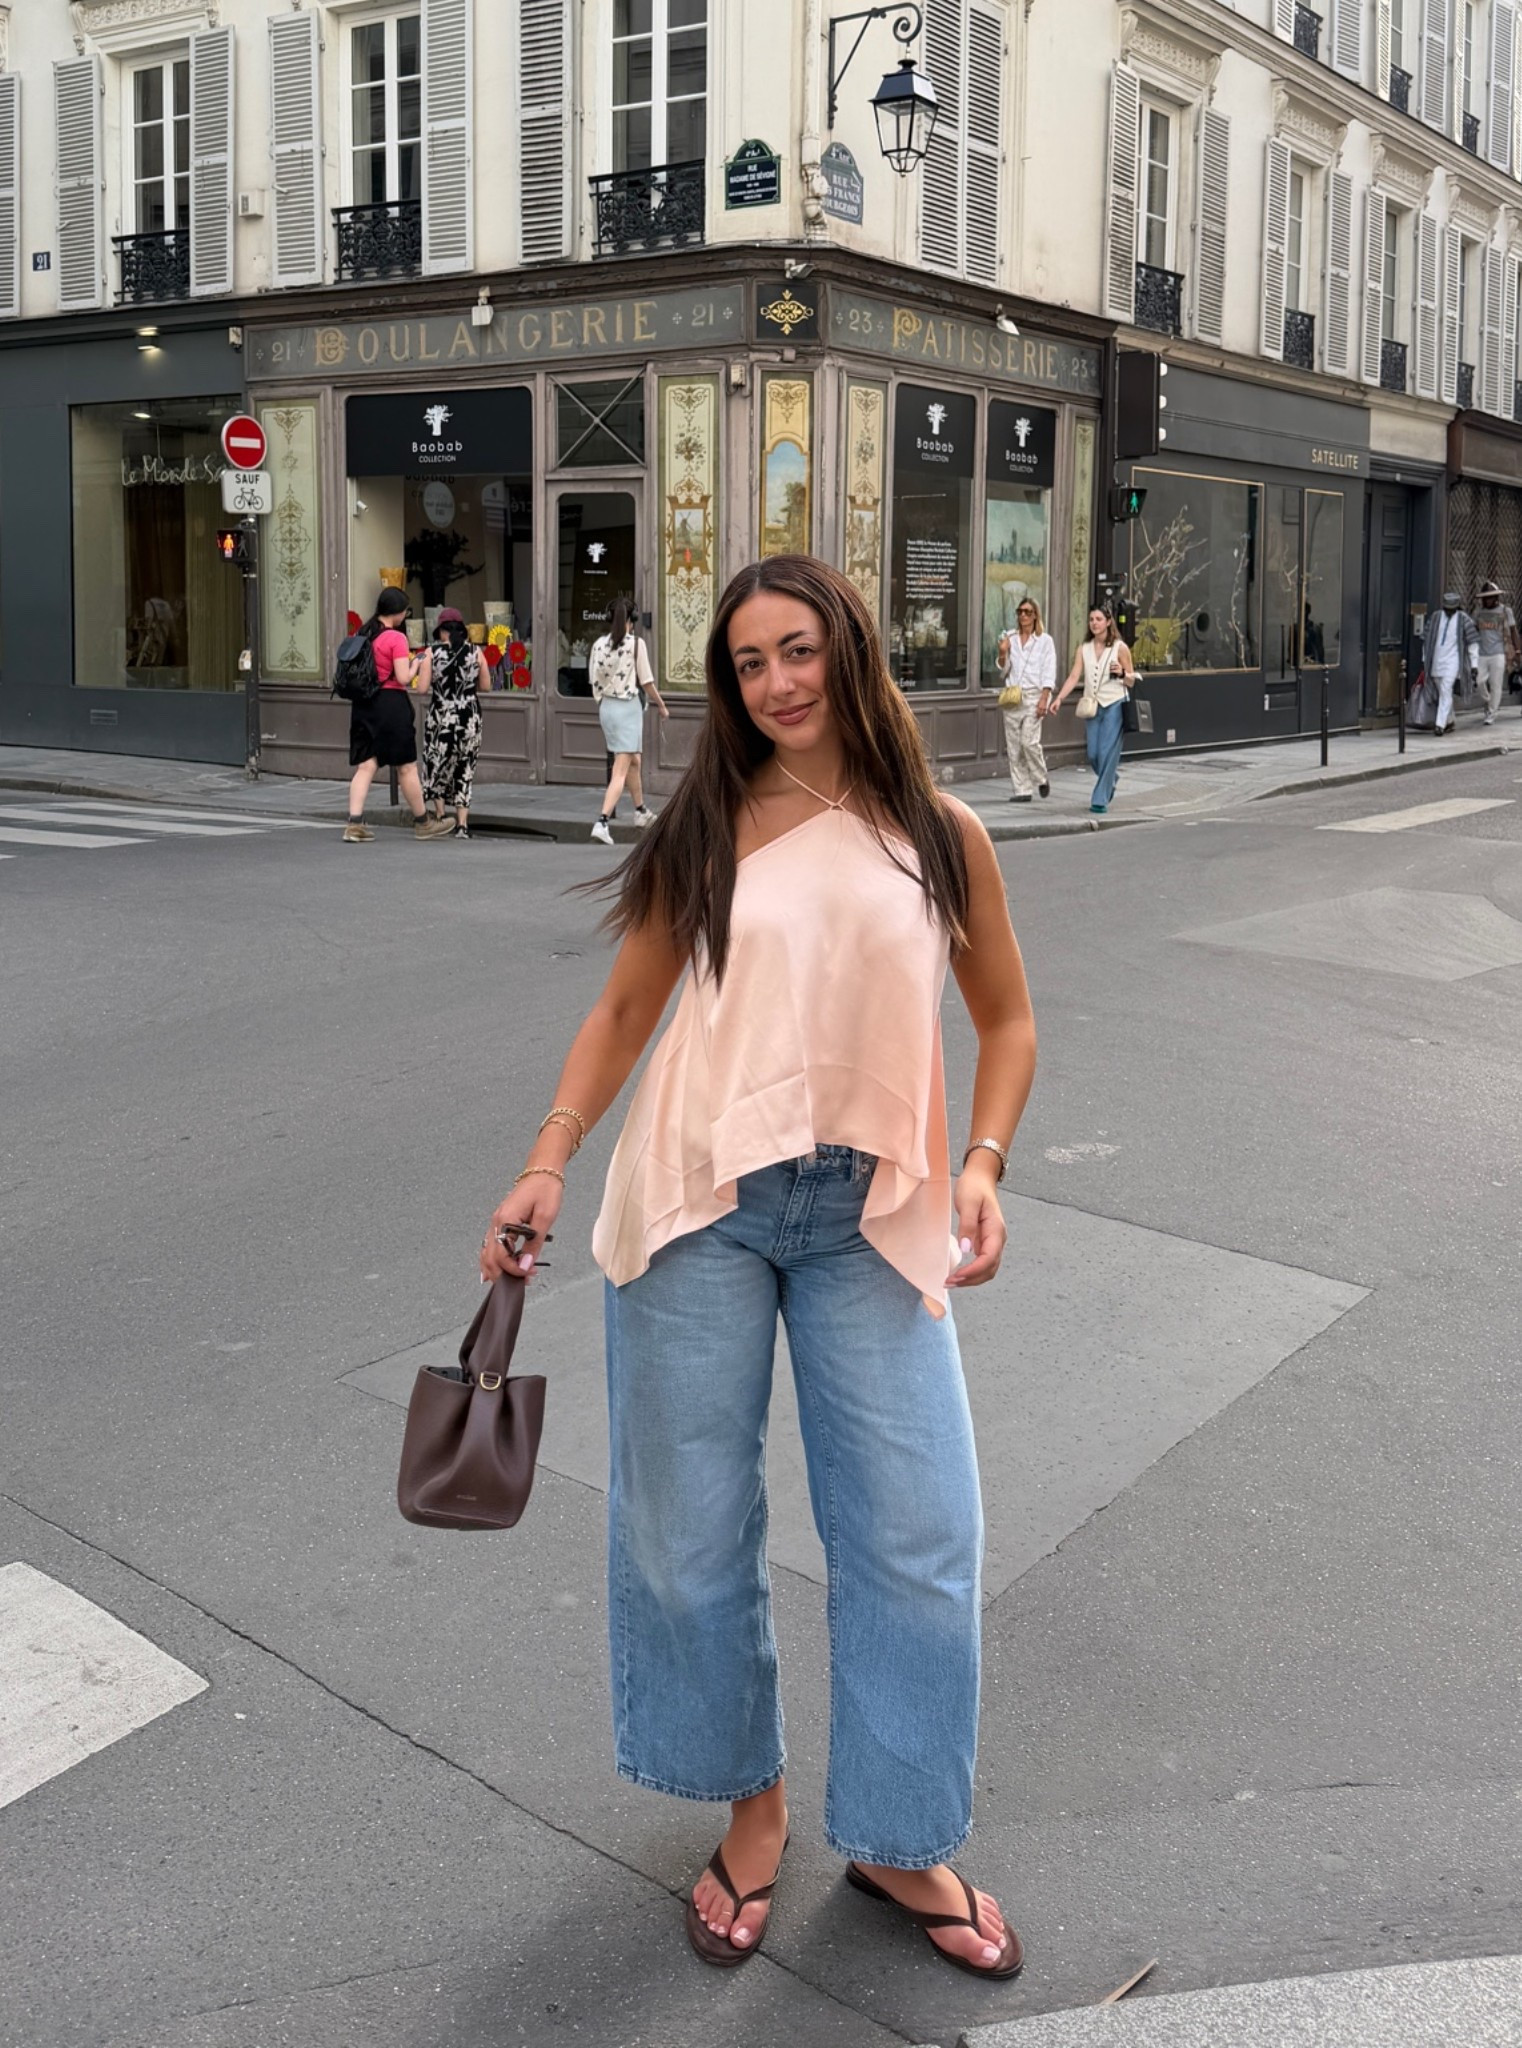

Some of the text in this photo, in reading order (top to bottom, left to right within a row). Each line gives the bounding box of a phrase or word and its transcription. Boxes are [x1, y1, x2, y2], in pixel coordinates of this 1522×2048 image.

[746, 164, 758, 172] RUE
[750, 172, 756, 181] DE
[832, 174, 848, 188] RUE
[833, 187, 861, 204] FRANCS
[821, 197, 859, 216] OURGEOIS
[36, 253, 48, 270] 21
[271, 300, 714, 367] 21 BOULANGERIE 21
[849, 307, 1088, 380] 23 PATISSERIE 23
[412, 441, 463, 453] Baobab
[916, 437, 954, 453] Baobab
[418, 455, 457, 463] COLLECTION
[1005, 449, 1039, 464] Baobab
[1311, 448, 1359, 470] SATELLITE
[143, 454, 198, 484] Monde
[235, 474, 261, 485] SAUF
